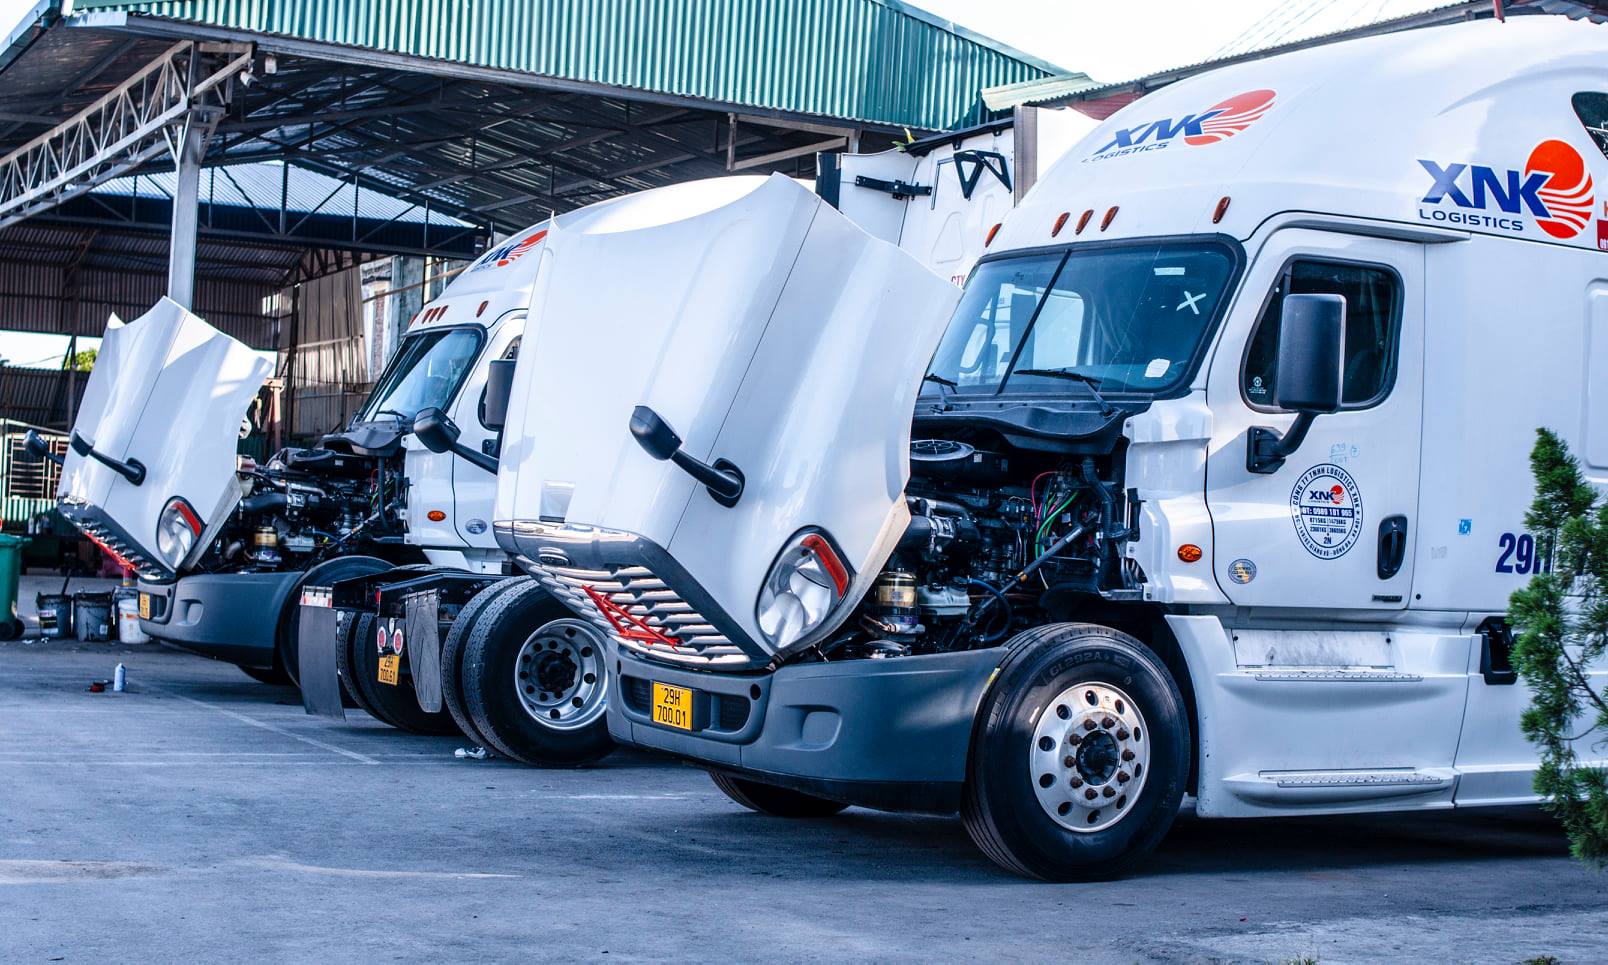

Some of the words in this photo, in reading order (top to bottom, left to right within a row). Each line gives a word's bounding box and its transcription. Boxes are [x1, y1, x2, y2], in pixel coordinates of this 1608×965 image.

[1092, 109, 1227, 156] XNK
[1080, 142, 1170, 163] LOGISTICS
[1416, 159, 1553, 218] XNK
[1418, 208, 1524, 231] LOGISTICS
[1309, 490, 1336, 501] XNK
[663, 687, 681, 706] 29H
[657, 704, 686, 727] 700.01
